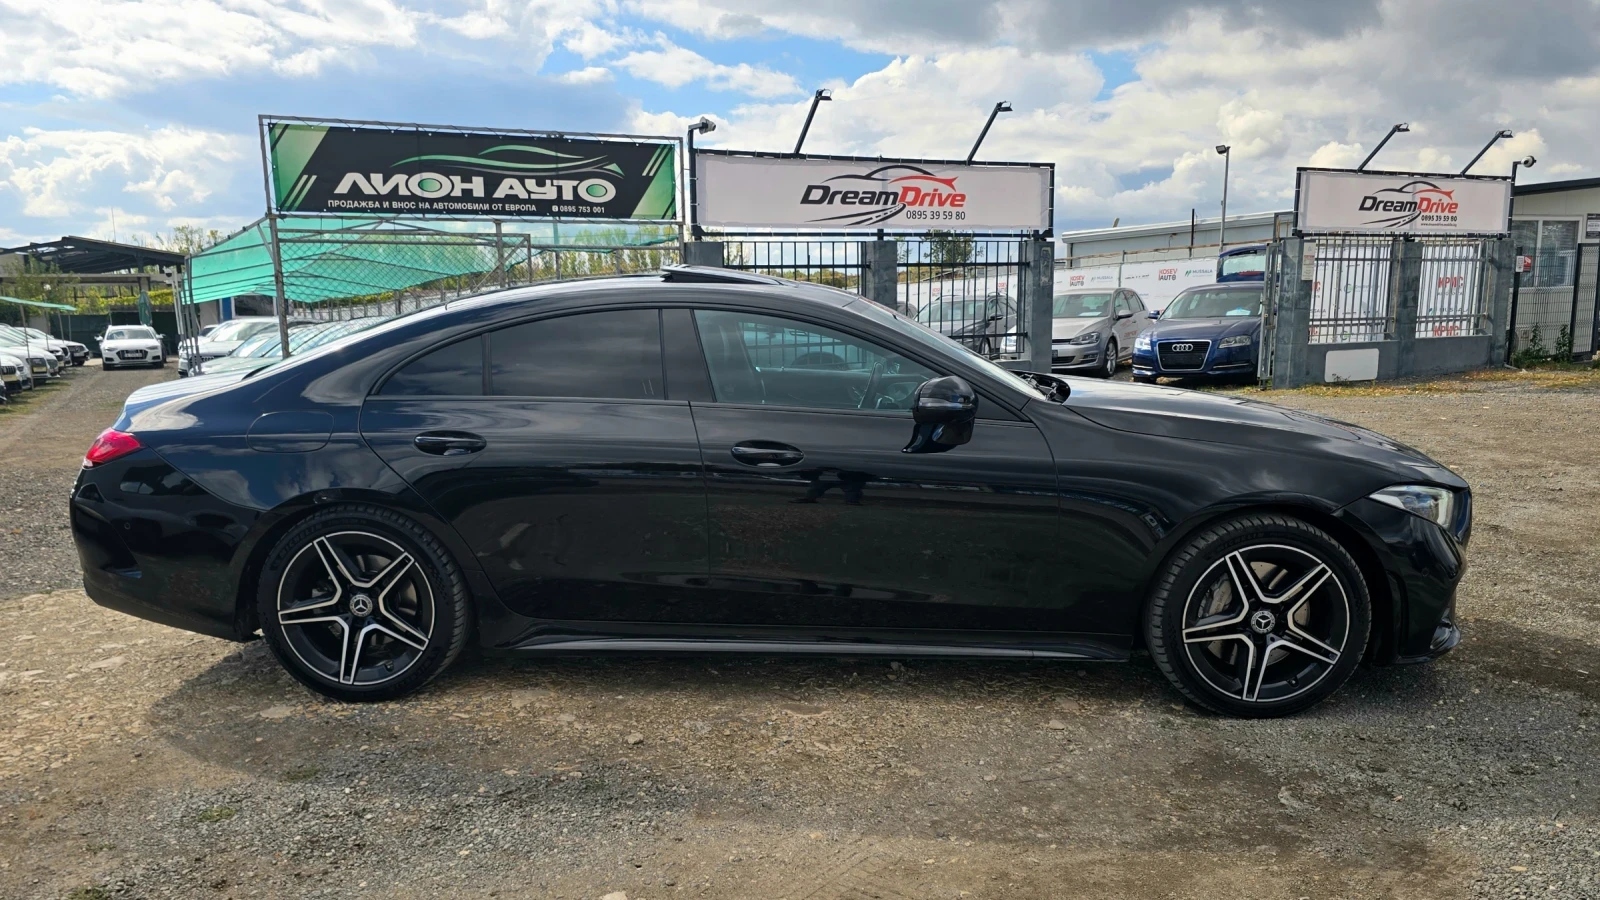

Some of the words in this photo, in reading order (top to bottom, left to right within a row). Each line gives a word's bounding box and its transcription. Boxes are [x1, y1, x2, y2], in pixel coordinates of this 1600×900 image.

[333, 172, 485, 198] ЛИОН
[492, 177, 616, 203] АУТО
[800, 184, 966, 208] DreamDrive
[327, 200, 380, 209] ПРОДАЖБА
[392, 201, 416, 209] ВНОС
[433, 202, 489, 211] АВТОМОБИЛИ
[492, 203, 502, 211] ОТ
[505, 204, 537, 212] ЕВРОПА
[560, 205, 576, 213] 0895
[1358, 195, 1458, 214] DreamDrive
[906, 210, 927, 219] 0895
[930, 210, 941, 220] 39
[943, 210, 953, 220] 59
[955, 211, 966, 220] 80
